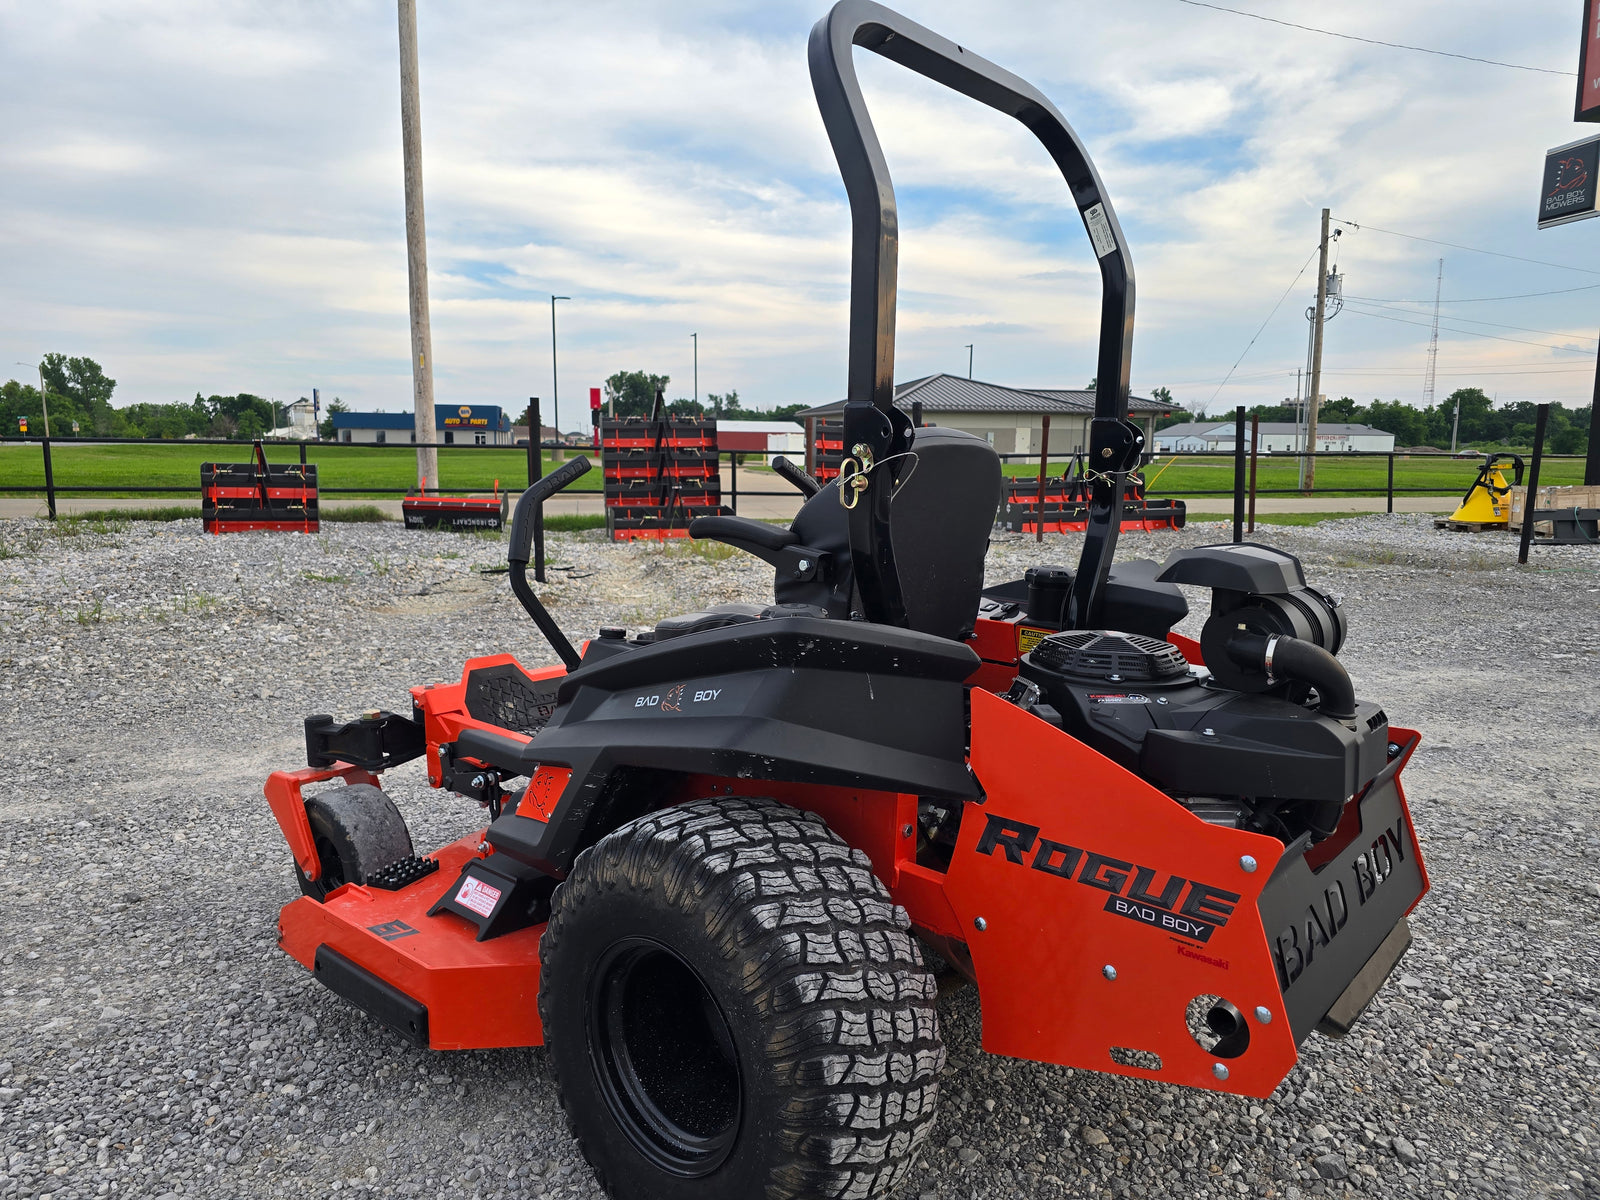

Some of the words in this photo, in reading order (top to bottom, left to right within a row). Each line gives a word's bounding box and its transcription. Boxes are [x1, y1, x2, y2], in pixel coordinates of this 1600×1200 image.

[1545, 195, 1585, 211] MOWERS
[1546, 194, 1564, 204] BAD
[1566, 188, 1586, 199] BOY
[634, 695, 660, 708] BAD
[693, 688, 722, 702] BOY
[1274, 879, 1348, 994] BAD
[1352, 816, 1405, 907] BOY
[1115, 900, 1156, 922] BAD
[1162, 914, 1205, 936] BOY
[1176, 945, 1230, 971] Kawasaki
